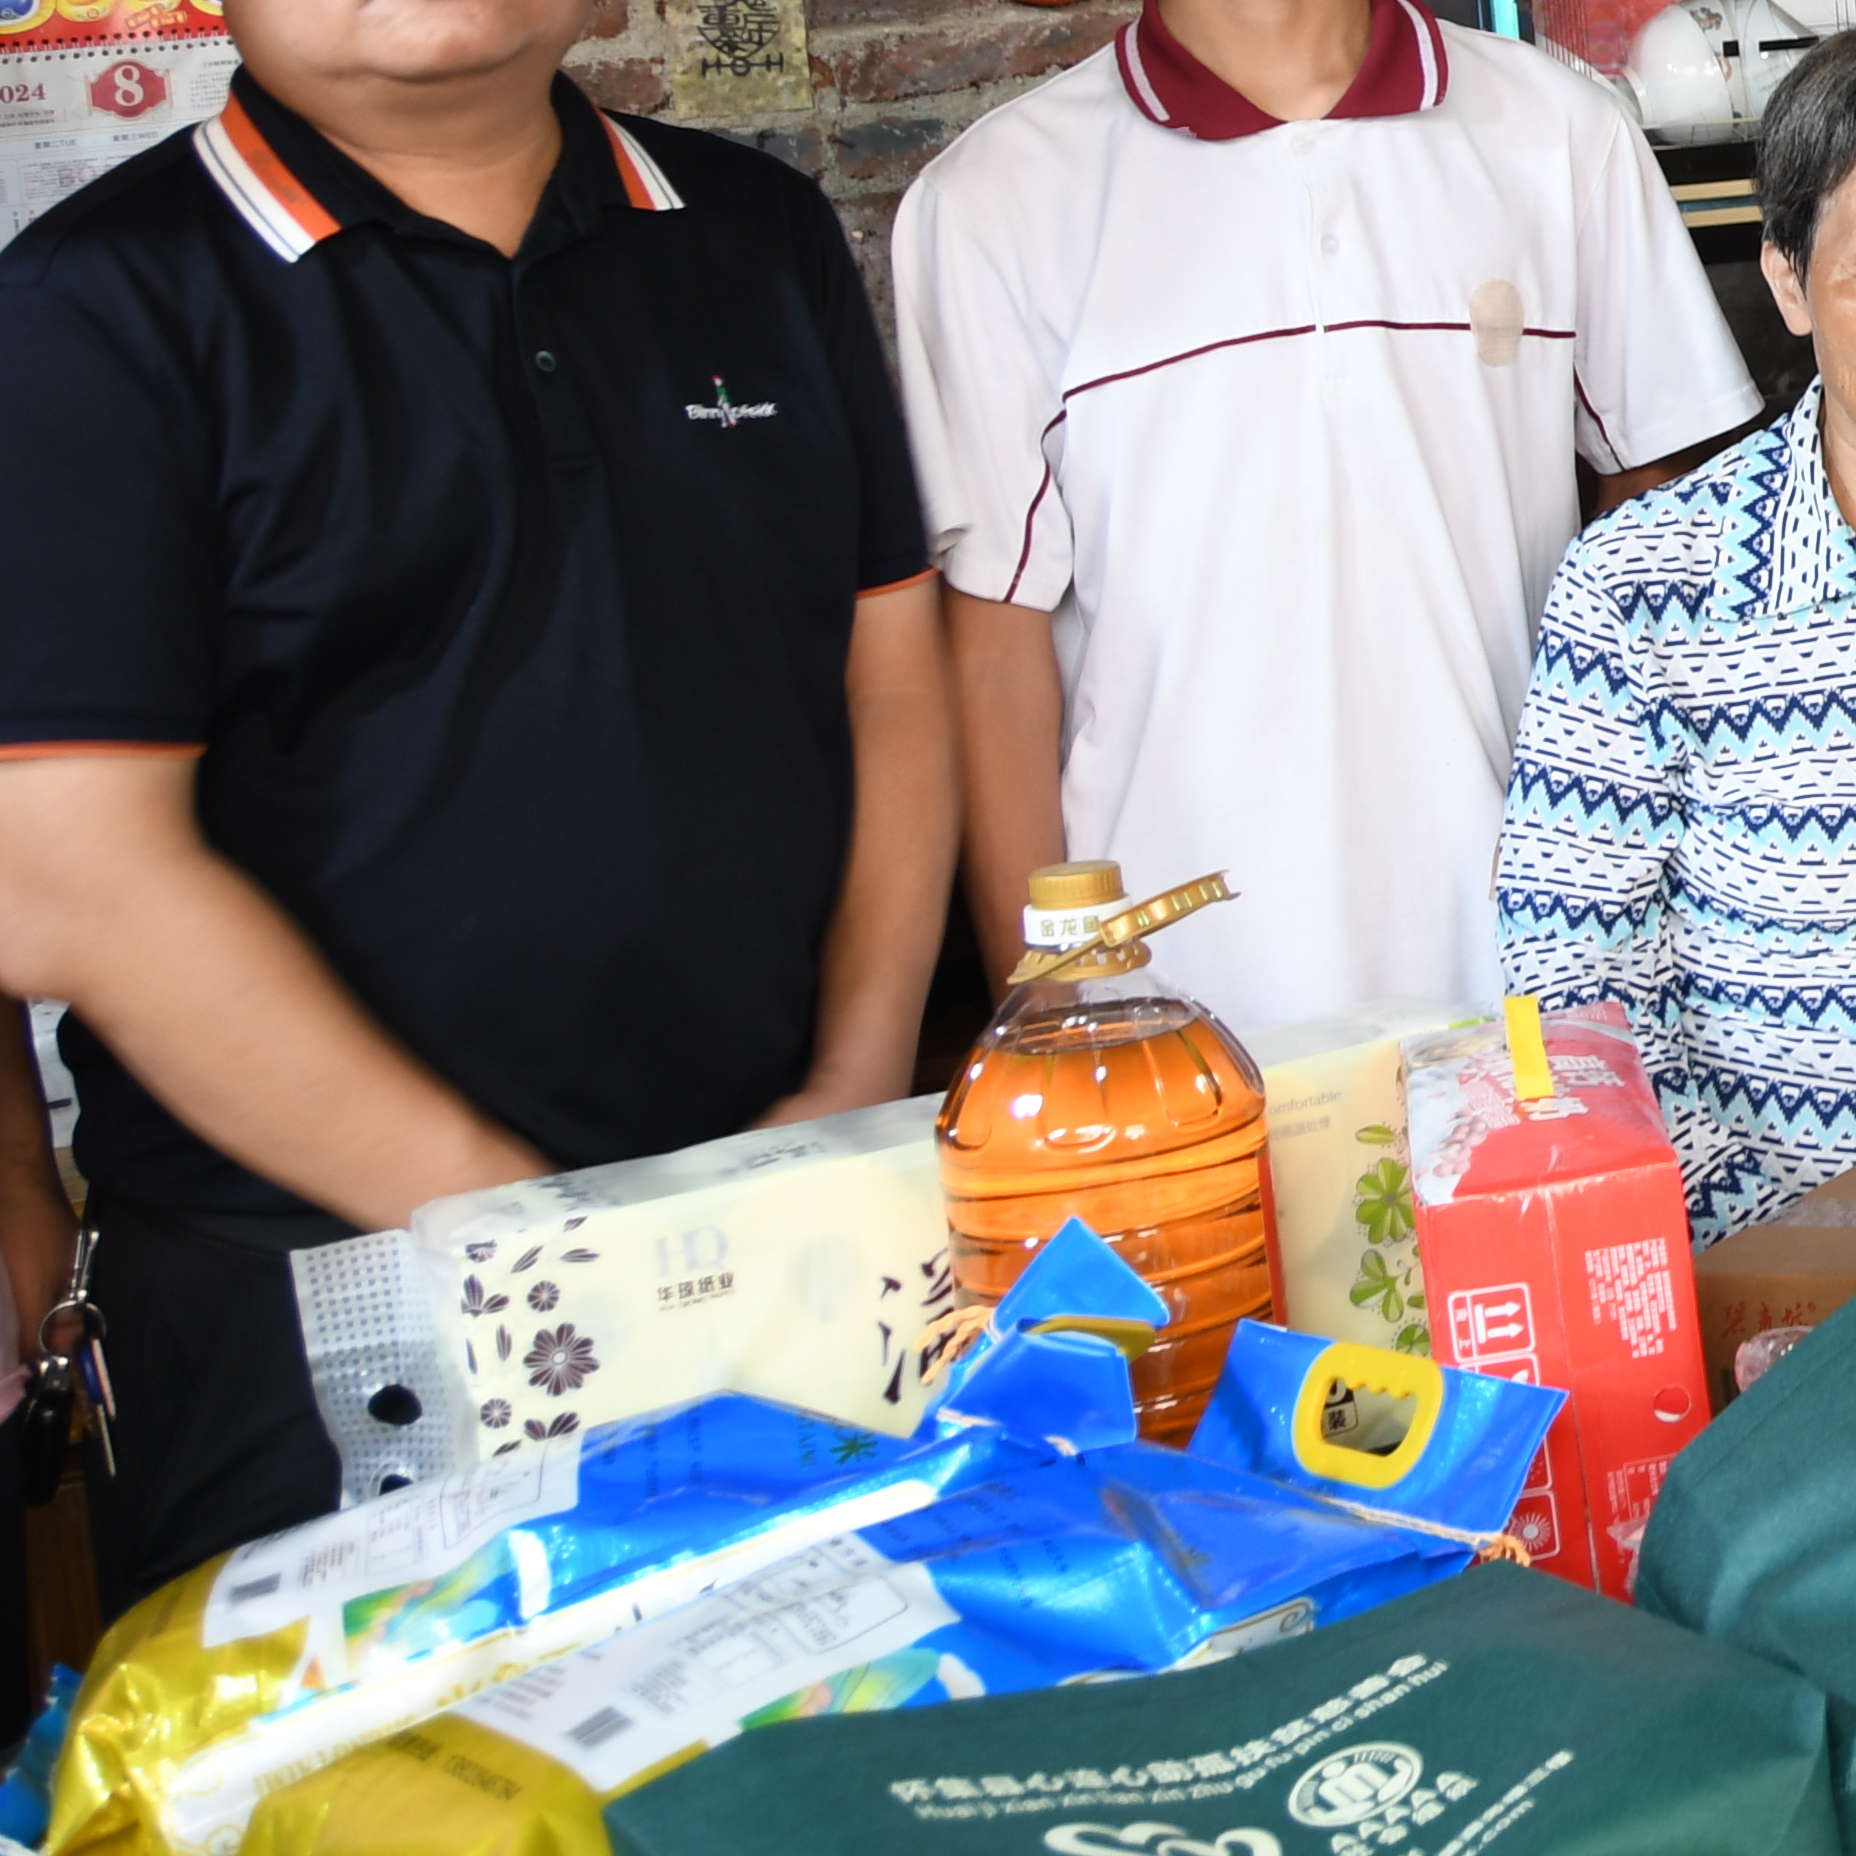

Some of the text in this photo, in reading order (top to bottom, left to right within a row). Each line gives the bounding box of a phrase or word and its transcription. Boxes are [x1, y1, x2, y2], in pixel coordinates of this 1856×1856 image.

[113, 64, 145, 107] 8
[1040, 915, 1100, 937] 金龙鱼
[1268, 1090, 1342, 1115] omfortable
